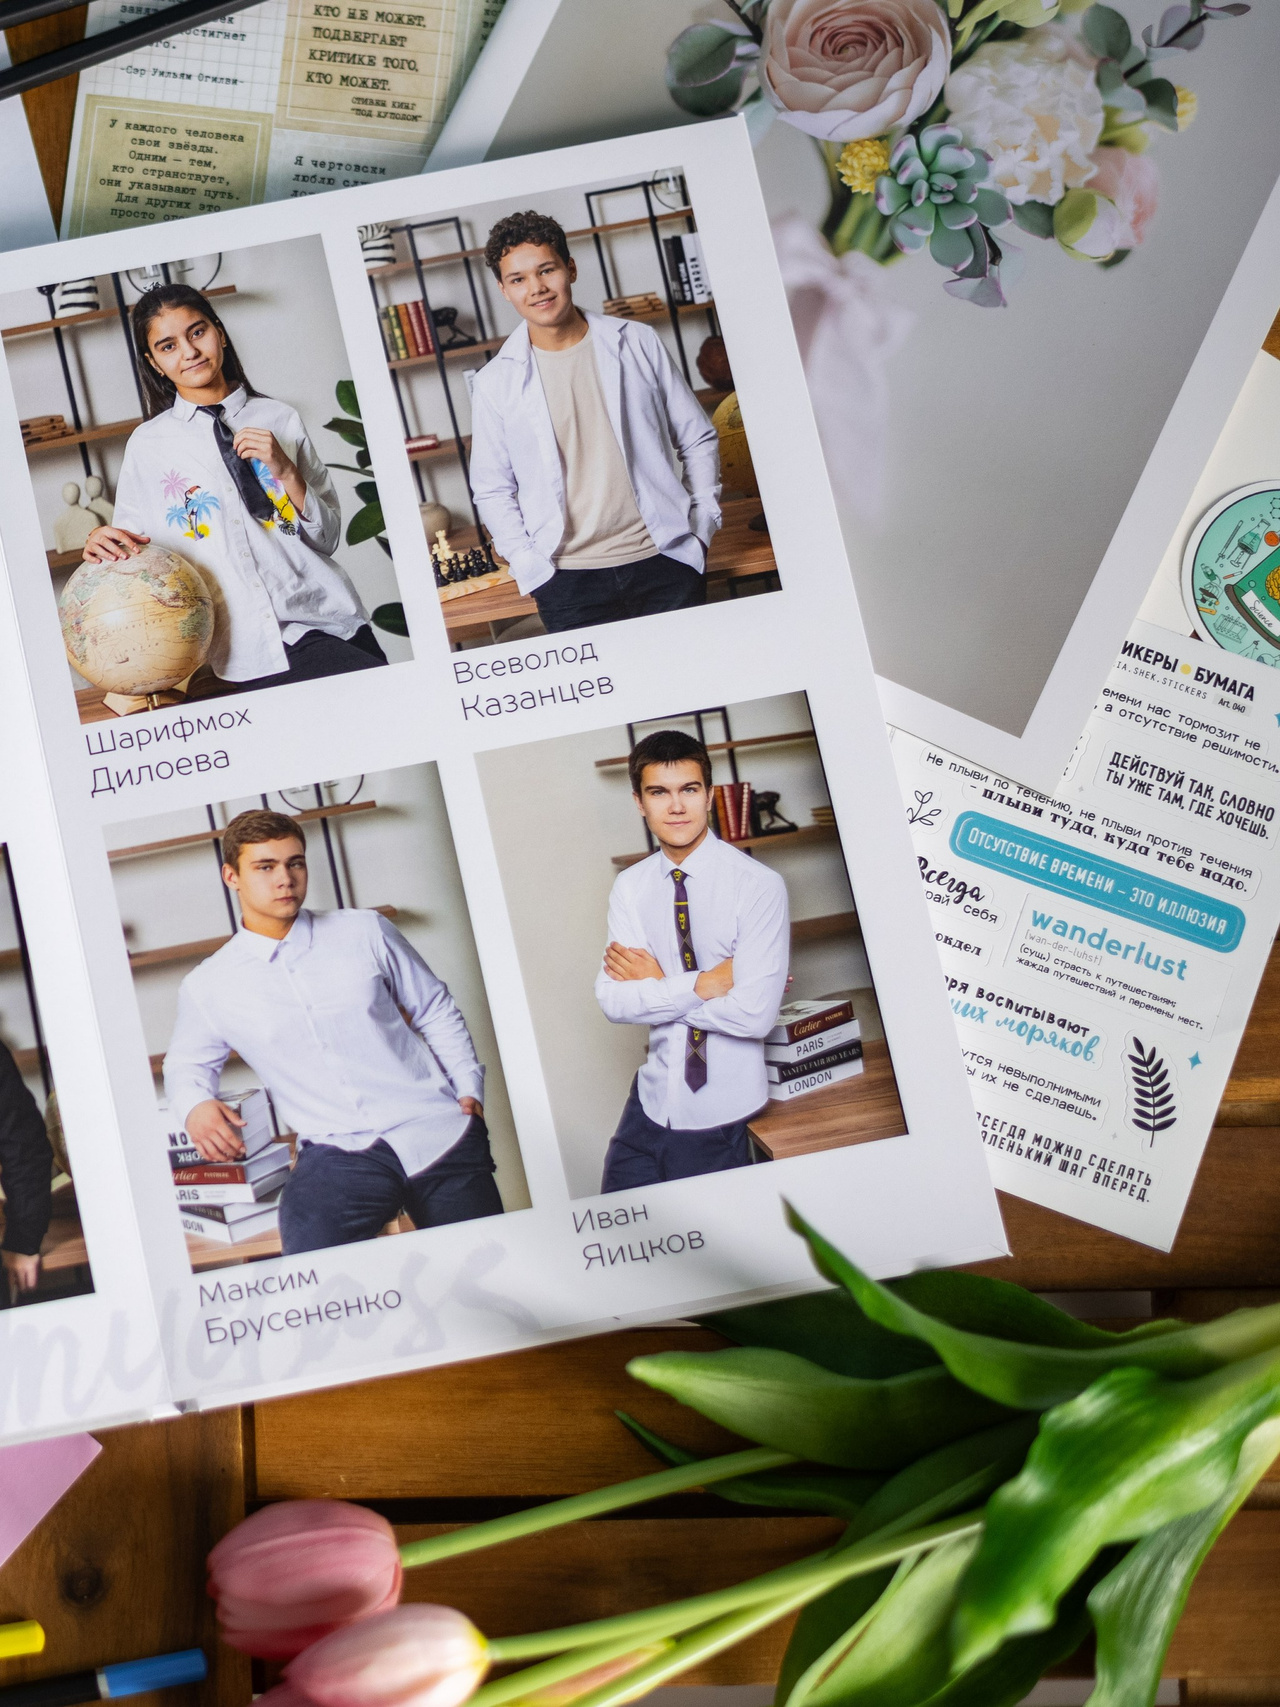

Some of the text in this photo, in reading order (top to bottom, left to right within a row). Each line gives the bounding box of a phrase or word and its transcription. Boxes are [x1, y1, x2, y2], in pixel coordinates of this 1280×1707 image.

[313, 4, 341, 18] КТО
[347, 7, 369, 20] НЕ
[312, 26, 407, 48] ПОДВЕРГАЕТ
[151, 67, 192, 81] Уильям
[308, 48, 377, 68] КРИТИКЕ
[305, 71, 333, 85] КТО
[351, 97, 387, 108] СТИВЕН
[125, 123, 177, 136] каждого
[185, 129, 245, 143] человека
[131, 137, 219, 154] свои звёзды.
[112, 164, 231, 186] кто странствует,
[128, 150, 217, 169] Одним тем,
[294, 156, 387, 176] Я чертовски
[99, 178, 241, 201] они указывают путь.
[292, 173, 336, 186] люблю
[110, 208, 155, 221] просто
[115, 192, 221, 213] Для других это
[1249, 599, 1274, 629] Science
[452, 641, 599, 685] Всеволод
[1113, 661, 1208, 700] IA.SHEK.STICKERS
[460, 675, 615, 721] Казанцев
[1193, 667, 1255, 701] БУМАГА
[85, 706, 253, 756] Шарифмох
[1102, 687, 1261, 751] емени нас тормозит не
[1118, 708, 1198, 743] отсутствие
[1202, 738, 1280, 774] решимости.
[91, 749, 231, 798] Дилоева
[1109, 751, 1185, 789] ДЕЙСТВУЙ
[1188, 778, 1215, 802] ТАК,
[1219, 790, 1275, 822] СЛОВНО
[926, 752, 1252, 879] Не плыви по течению, не плыви против течения
[1105, 769, 1269, 840] ТЫ УЖЕ ТАМ, ГДЕ ХОЧЕШЬ.
[982, 788, 1248, 893] плыви туда, куда тебе надо.
[968, 827, 1227, 935] ОТСУТСТВИЕ ВРЕМЕНИ ЭТО ИЛЛЮЗИЯ
[963, 904, 998, 924] себя
[1024, 929, 1103, 966] [wan-der-luhst]
[1031, 910, 1187, 981] wanderlust
[1016, 956, 1204, 1030] жажда путешествий и перемены мест.
[1019, 943, 1177, 1008] (сущ.) страсть к путешествиям;
[793, 1019, 821, 1037] Cartier
[975, 987, 1090, 1038] воспитывают
[796, 1037, 824, 1056] PARIS
[788, 1070, 833, 1094] LONDON
[981, 1072, 1097, 1121] их не сделаешь.
[997, 1062, 1101, 1108] невыполнимыми
[1031, 1132, 1083, 1161] МОЖНО
[1088, 1153, 1152, 1187] СДЕЛАТЬ
[1058, 1158, 1088, 1179] ШАГ
[1092, 1171, 1150, 1203] ВПЕРЕД.
[571, 1203, 650, 1235] Иван
[582, 1229, 706, 1271] Яицков
[199, 1266, 319, 1307] Максим
[204, 1287, 403, 1346] Брусененко
